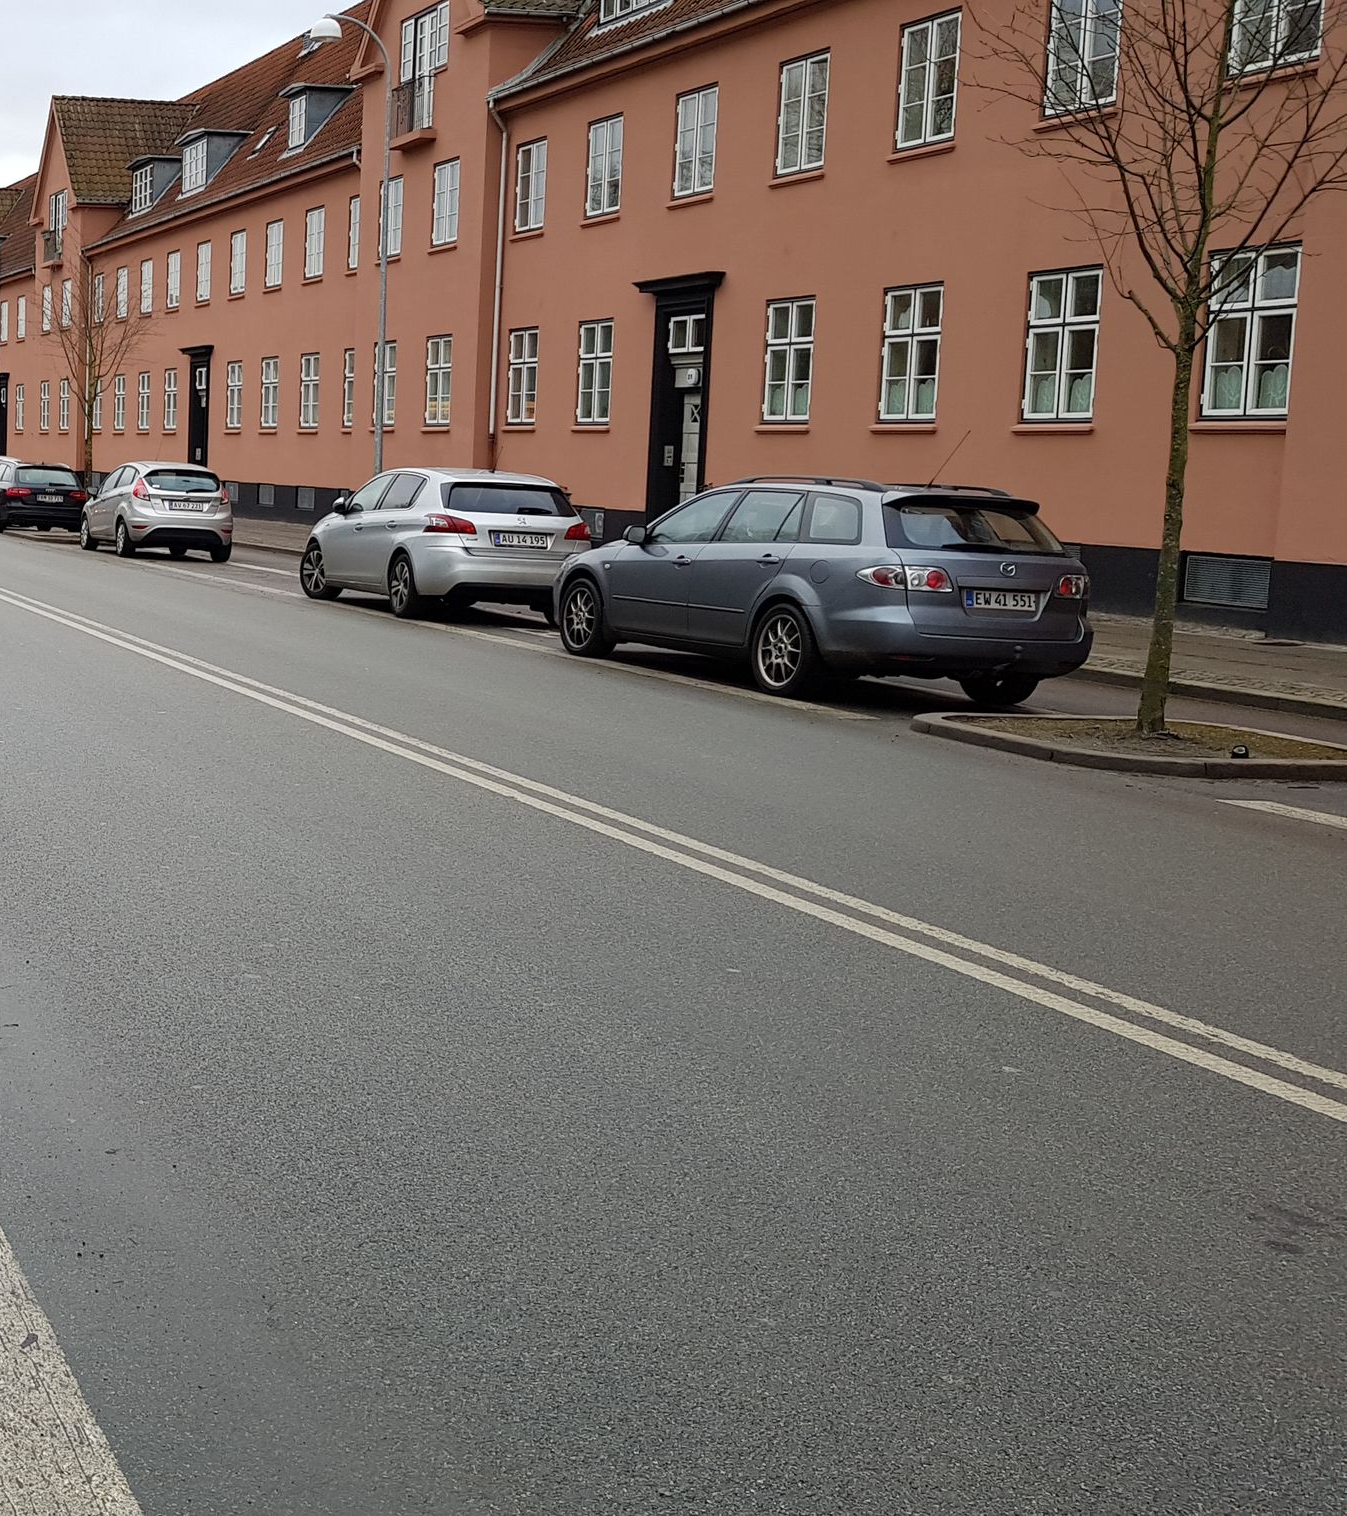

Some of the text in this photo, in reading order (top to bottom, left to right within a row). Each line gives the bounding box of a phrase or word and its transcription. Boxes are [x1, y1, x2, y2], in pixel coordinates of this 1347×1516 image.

[502, 535, 514, 543] AU
[517, 535, 527, 544] 14
[529, 536, 545, 545] 195
[975, 592, 992, 606] EW
[995, 593, 1008, 607] 41
[1012, 594, 1033, 608] 551
